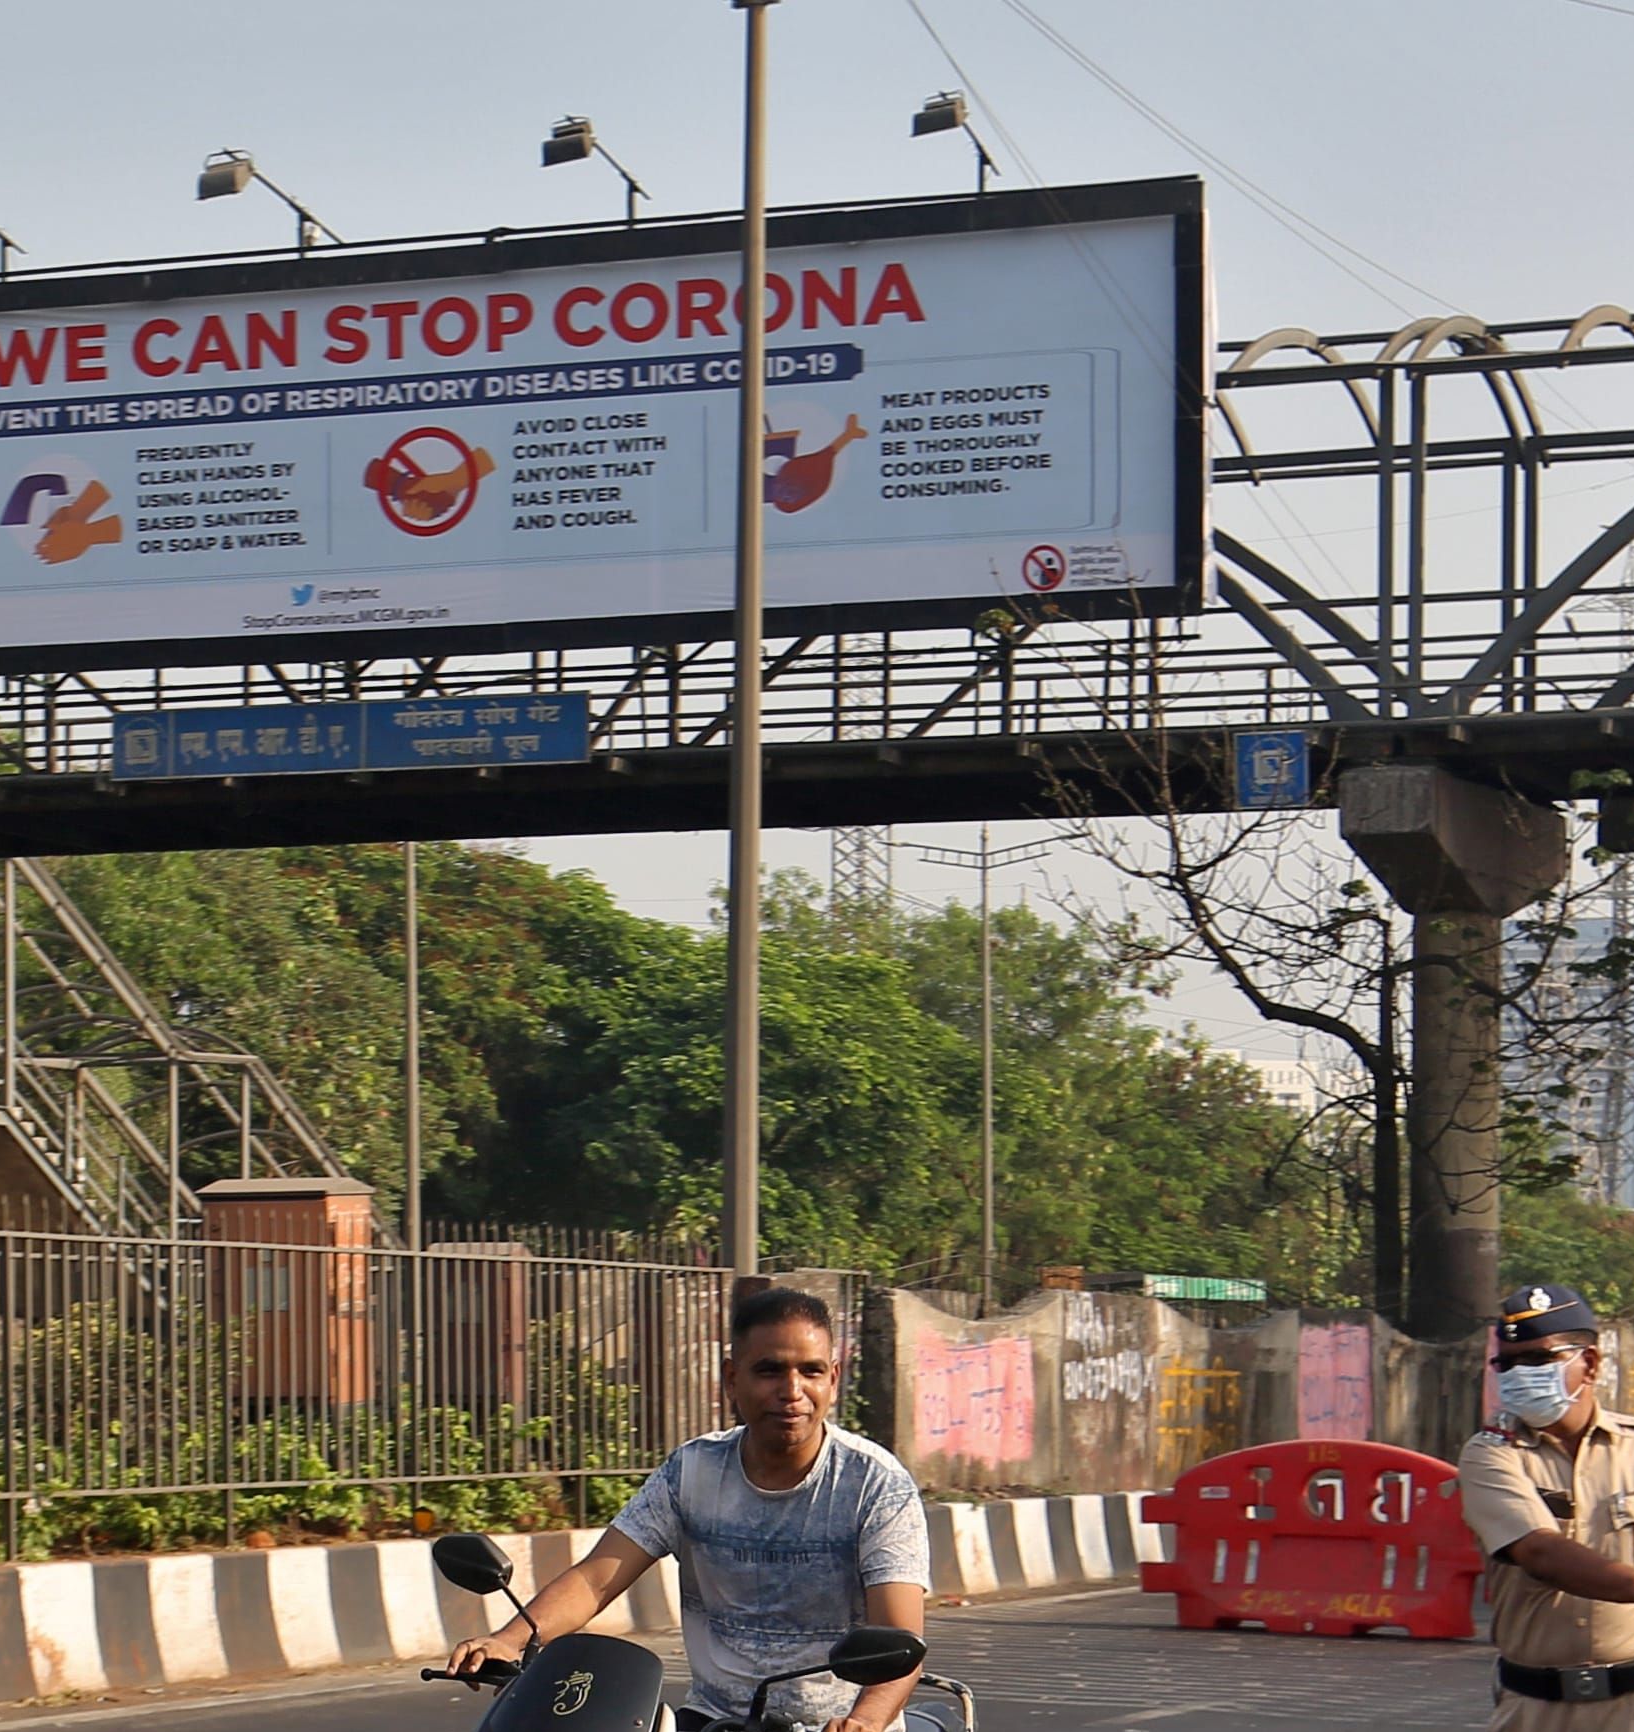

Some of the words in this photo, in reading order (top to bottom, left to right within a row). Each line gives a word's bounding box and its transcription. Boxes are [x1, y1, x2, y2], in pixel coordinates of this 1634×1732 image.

[133, 310, 298, 377] CAN
[323, 292, 533, 364] STOP
[553, 262, 926, 347] CORONA
[66, 401, 120, 425] THE
[127, 393, 234, 423] SPREAD
[245, 391, 280, 414] OF
[290, 378, 477, 412] RESPIRATORY
[486, 367, 624, 398] DISEASES
[632, 361, 696, 389] LIKE
[704, 352, 837, 383] COID-19
[881, 391, 936, 408] MEAT
[941, 384, 1050, 405] PRODUCTS
[513, 417, 577, 435] AVOID
[582, 413, 648, 431] CLOSE
[880, 417, 924, 434] AND
[930, 413, 983, 431] EGGS
[988, 409, 1044, 427] MUST
[136, 442, 254, 462] FREQUENTLY
[512, 440, 608, 459] CONTACT
[614, 436, 667, 453] WITH
[881, 441, 907, 456] BE
[914, 433, 1042, 453] THOROUGHLY
[137, 469, 198, 485] CLEAN
[202, 464, 266, 481] HANDS
[271, 462, 296, 477] BY
[513, 464, 598, 483] ANYONE
[602, 461, 656, 477] THAT
[880, 459, 965, 477] COOKED
[971, 454, 1052, 472] BEFORE
[137, 492, 193, 508] USING
[197, 487, 290, 505] ALCOHOL-
[512, 491, 552, 507] HAS
[558, 487, 621, 504] FEVER
[881, 478, 1011, 499] CONSUMING.
[137, 515, 197, 531] BASED
[202, 509, 299, 528] SANITIZER
[513, 514, 556, 530] AND
[561, 510, 637, 527] COUGH.
[138, 540, 163, 554] OR
[168, 537, 216, 552] SOAP
[221, 535, 234, 550] &
[238, 532, 307, 548] WATER.
